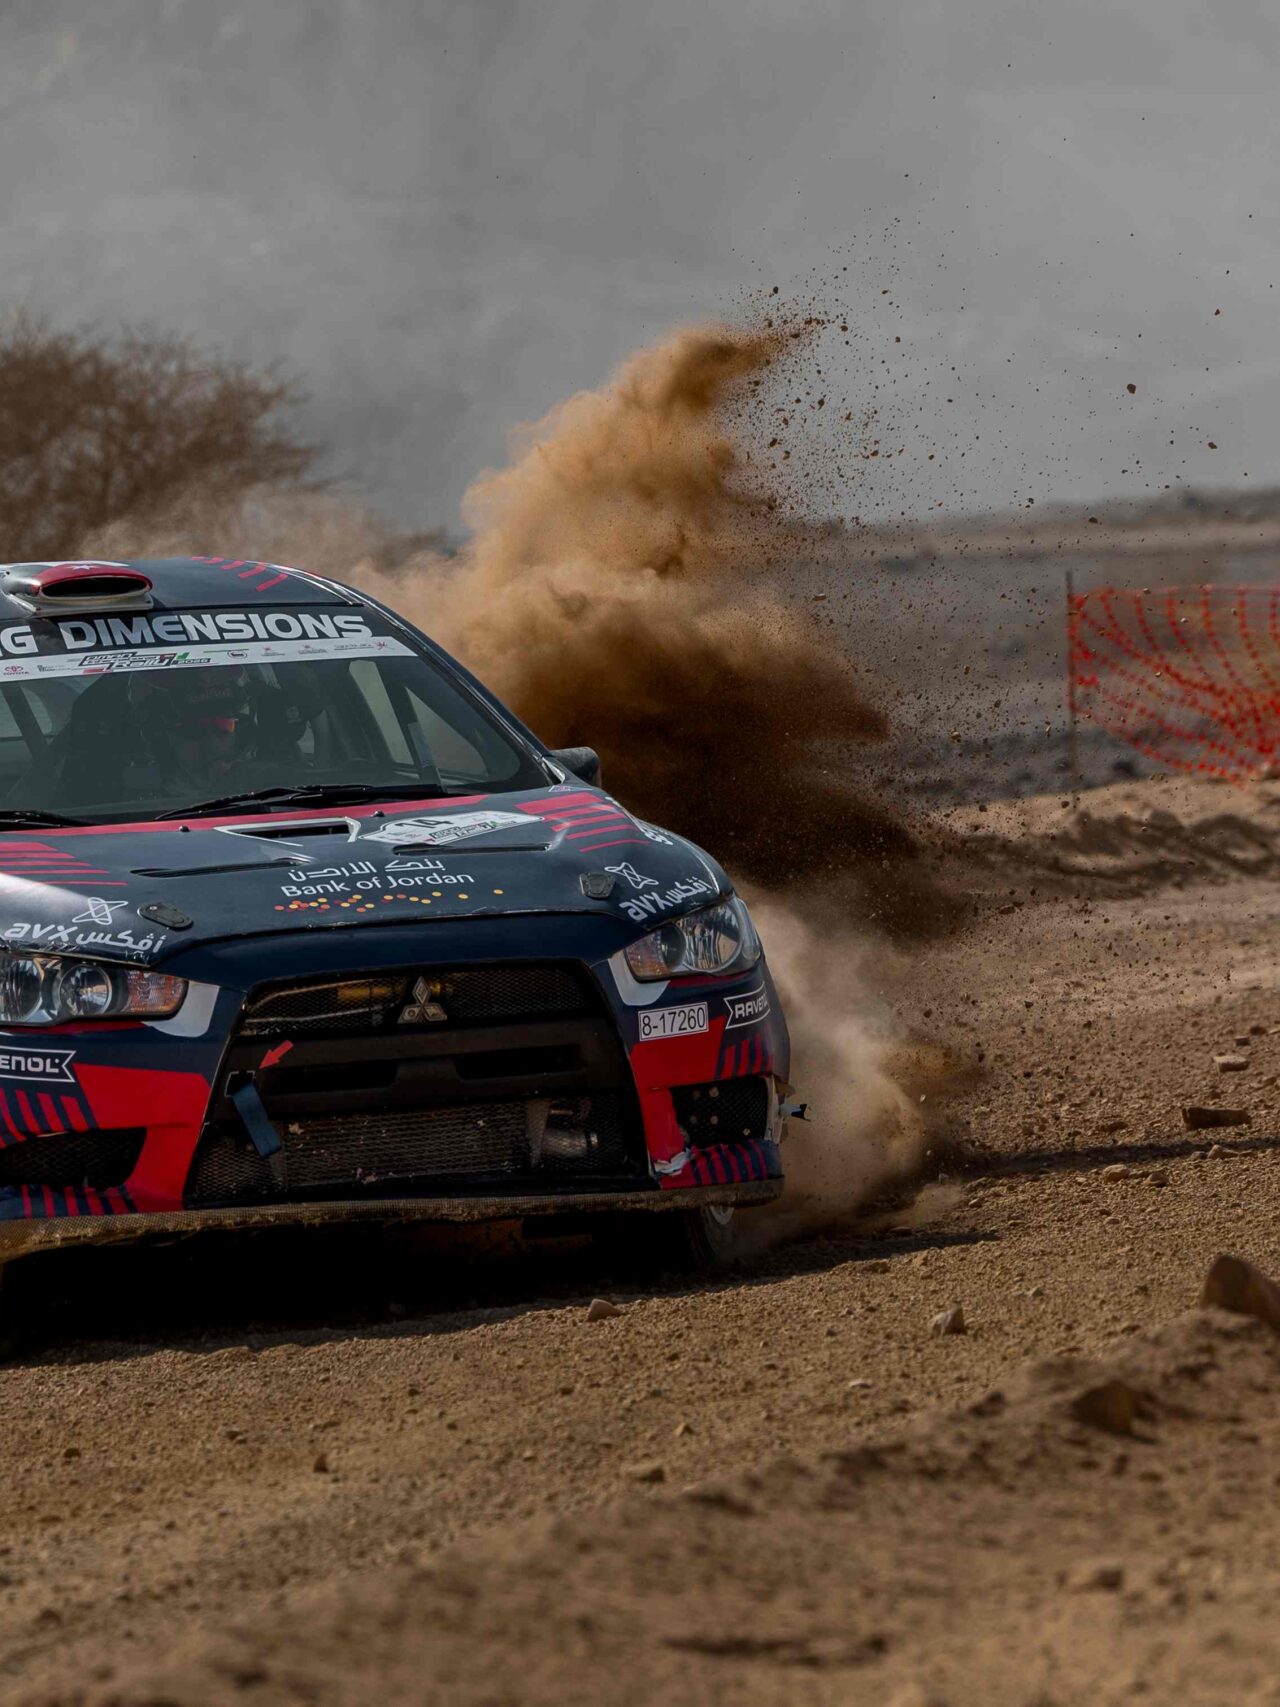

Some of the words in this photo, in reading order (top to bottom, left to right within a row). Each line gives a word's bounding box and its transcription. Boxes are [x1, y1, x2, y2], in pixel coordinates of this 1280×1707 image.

[57, 613, 373, 650] DIMENSIONS
[281, 880, 351, 897] Bank
[356, 876, 382, 890] of
[386, 872, 475, 889] Jordan
[642, 1006, 706, 1036] 8-17260
